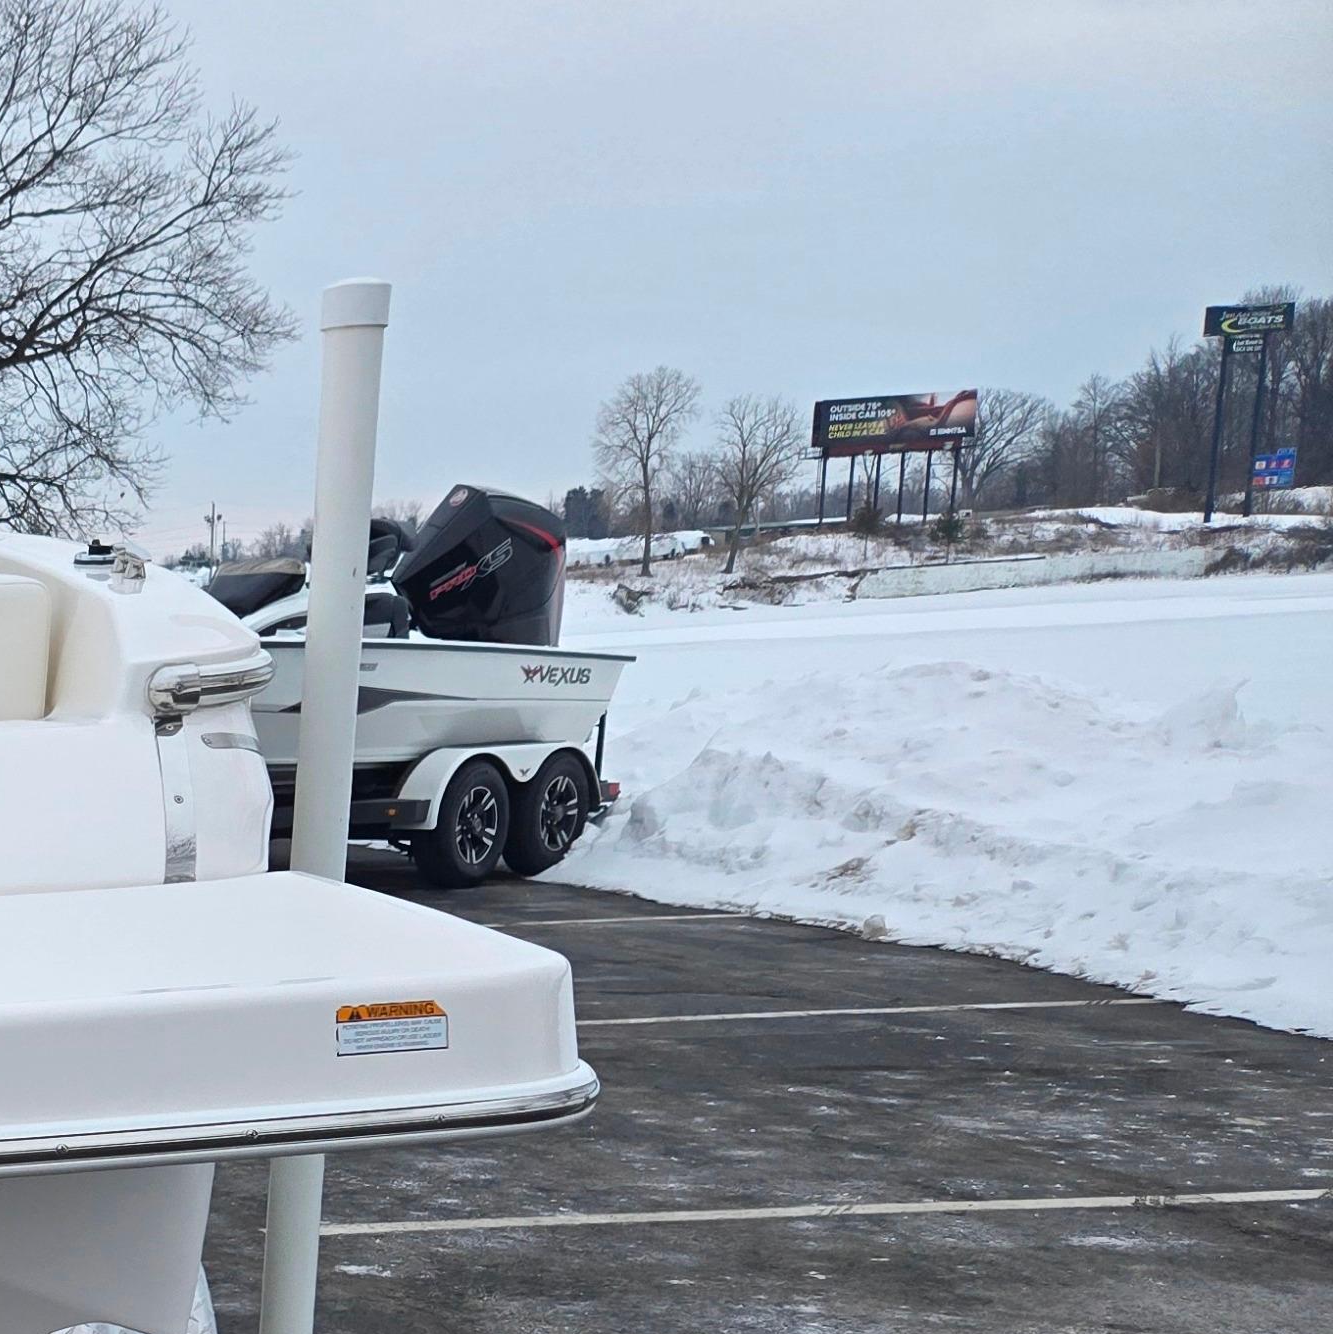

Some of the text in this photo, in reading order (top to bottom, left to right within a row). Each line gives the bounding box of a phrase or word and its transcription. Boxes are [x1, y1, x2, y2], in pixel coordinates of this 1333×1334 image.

[1238, 315, 1284, 325] BOATS
[830, 403, 866, 414] OUTSIDE
[829, 412, 856, 422] INSIDE
[857, 411, 876, 420] CAR
[829, 423, 853, 432] NEVER
[828, 430, 851, 439] CHILD
[539, 664, 591, 687] VEXUS
[367, 1003, 435, 1017] WARNING
